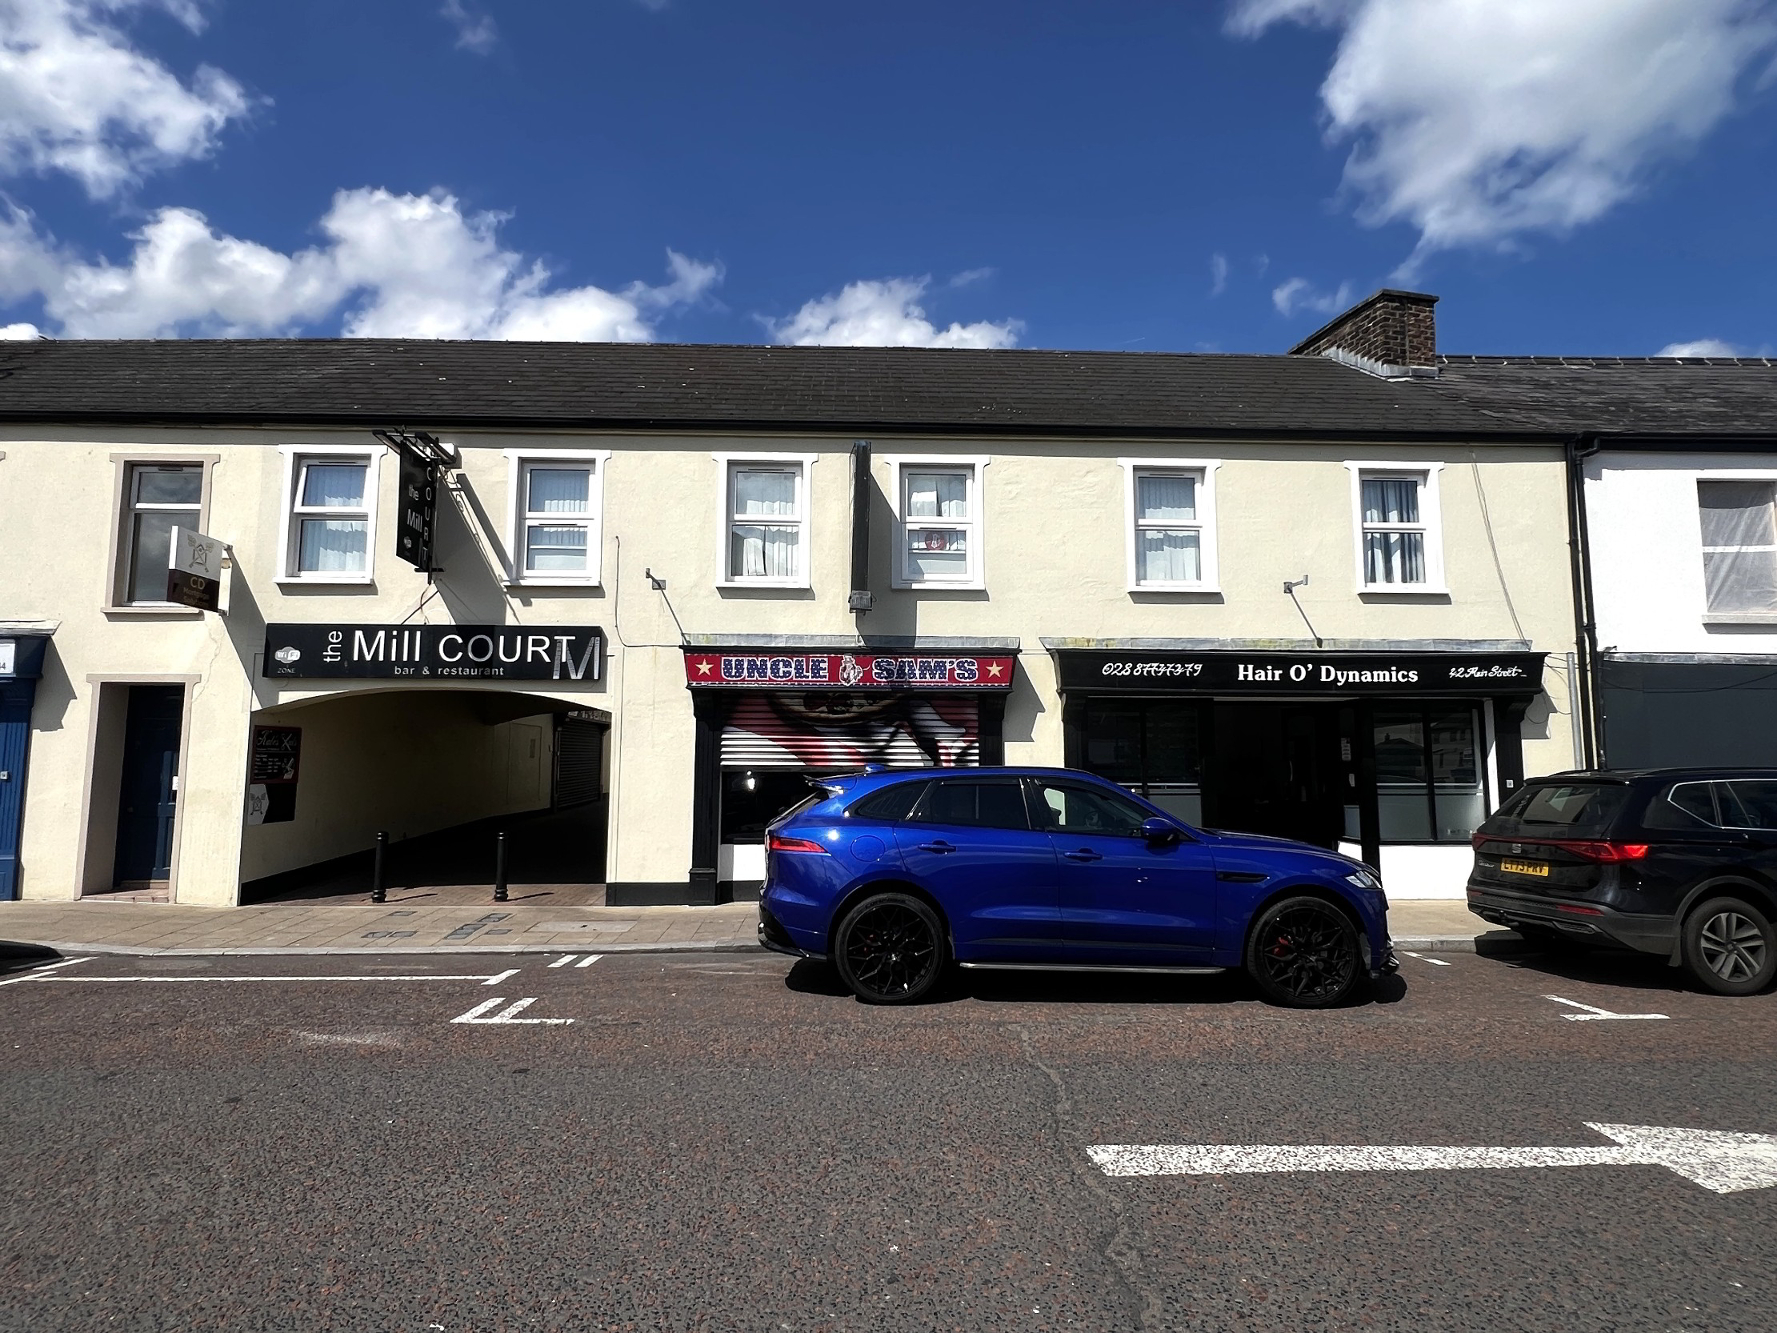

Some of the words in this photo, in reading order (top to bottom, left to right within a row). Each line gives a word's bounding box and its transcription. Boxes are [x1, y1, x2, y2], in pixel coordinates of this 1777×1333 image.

[408, 484, 420, 501] the
[406, 508, 423, 533] Mill
[422, 466, 433, 561] COURT
[190, 576, 206, 590] CD
[323, 630, 343, 663] the
[353, 629, 422, 662] Mill
[438, 634, 576, 663] COURT
[394, 666, 415, 675] bar
[422, 666, 430, 675] &
[437, 666, 504, 676] restaurant
[720, 656, 829, 681] UNCLE
[871, 657, 980, 682] SAM'S
[1102, 662, 1133, 676] 028
[1237, 664, 1283, 681] Hair
[1319, 665, 1419, 686] Dynamics
